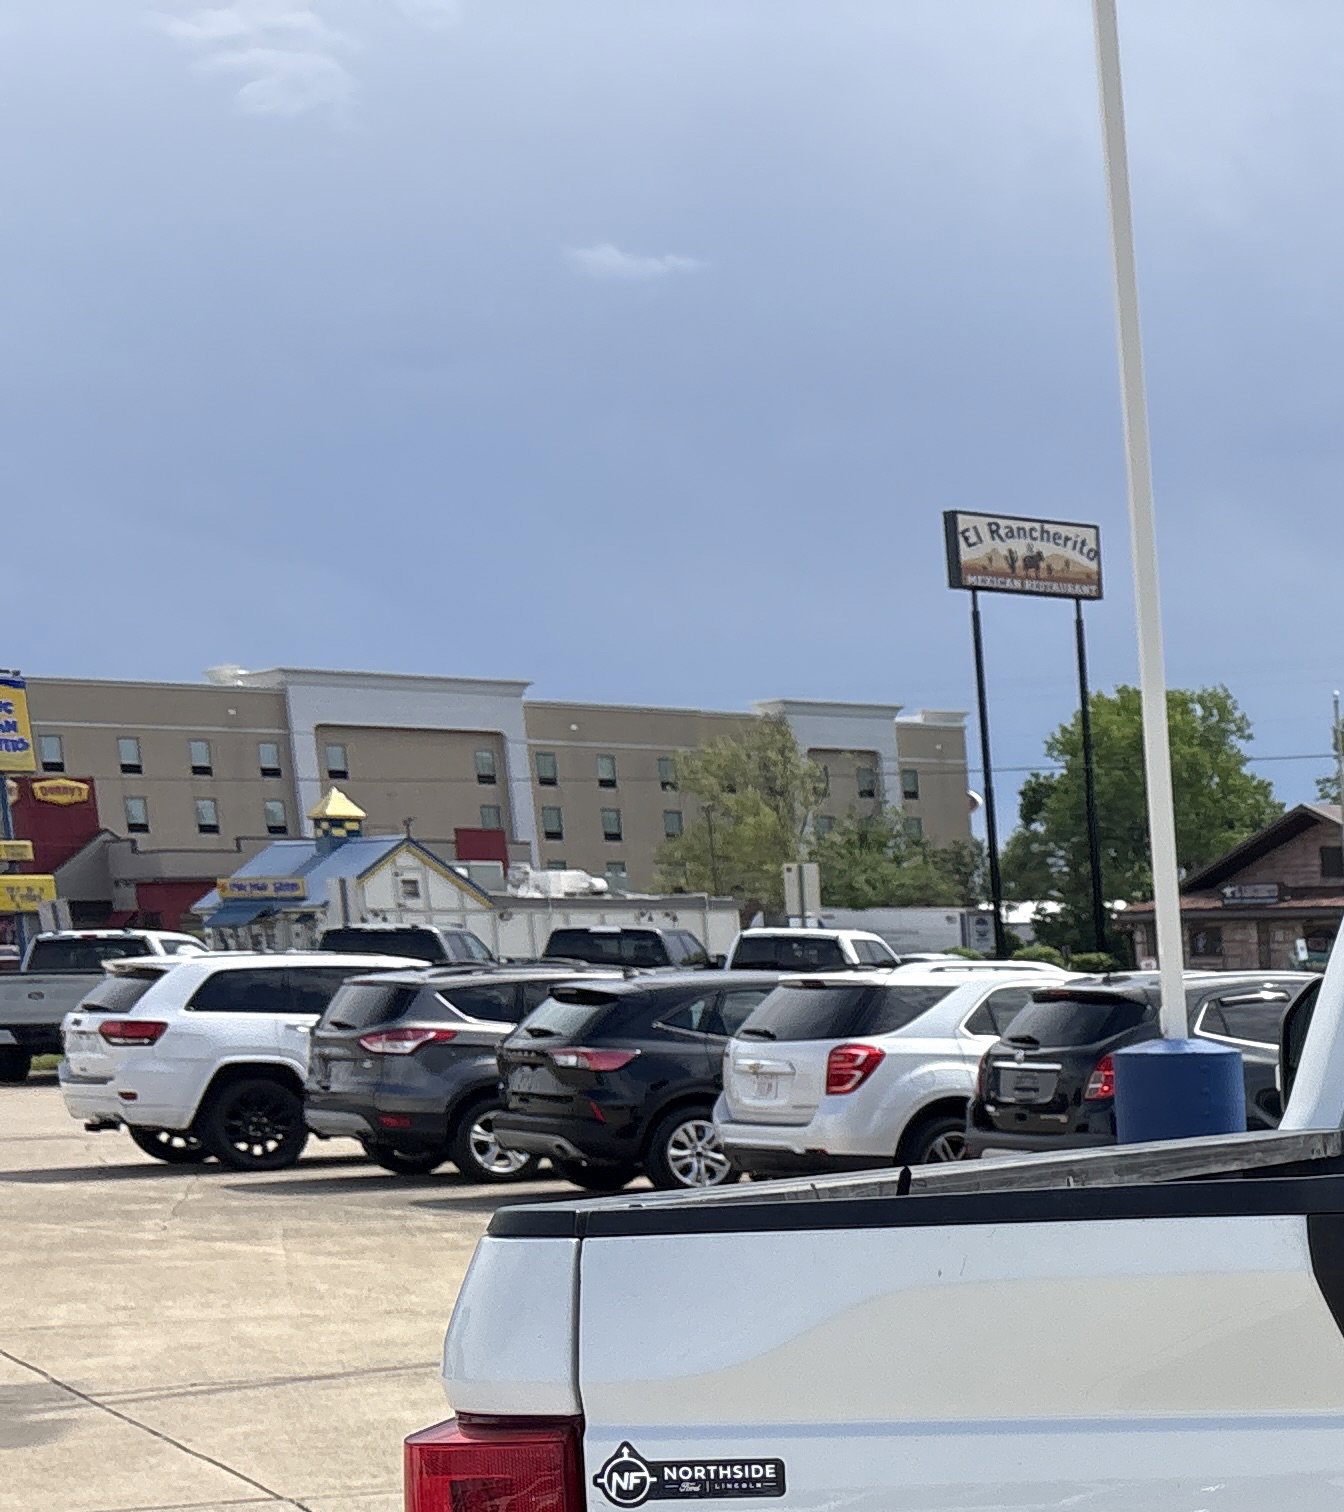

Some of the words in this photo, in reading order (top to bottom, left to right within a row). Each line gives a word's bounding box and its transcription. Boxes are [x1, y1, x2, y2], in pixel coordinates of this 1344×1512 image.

[960, 526, 983, 548] El
[987, 521, 1098, 561] Rancherito
[663, 1464, 777, 1480] NORTHSIDE
[612, 1471, 649, 1496] NF
[678, 1481, 701, 1493] Ford
[714, 1482, 762, 1490] LINCOLN
